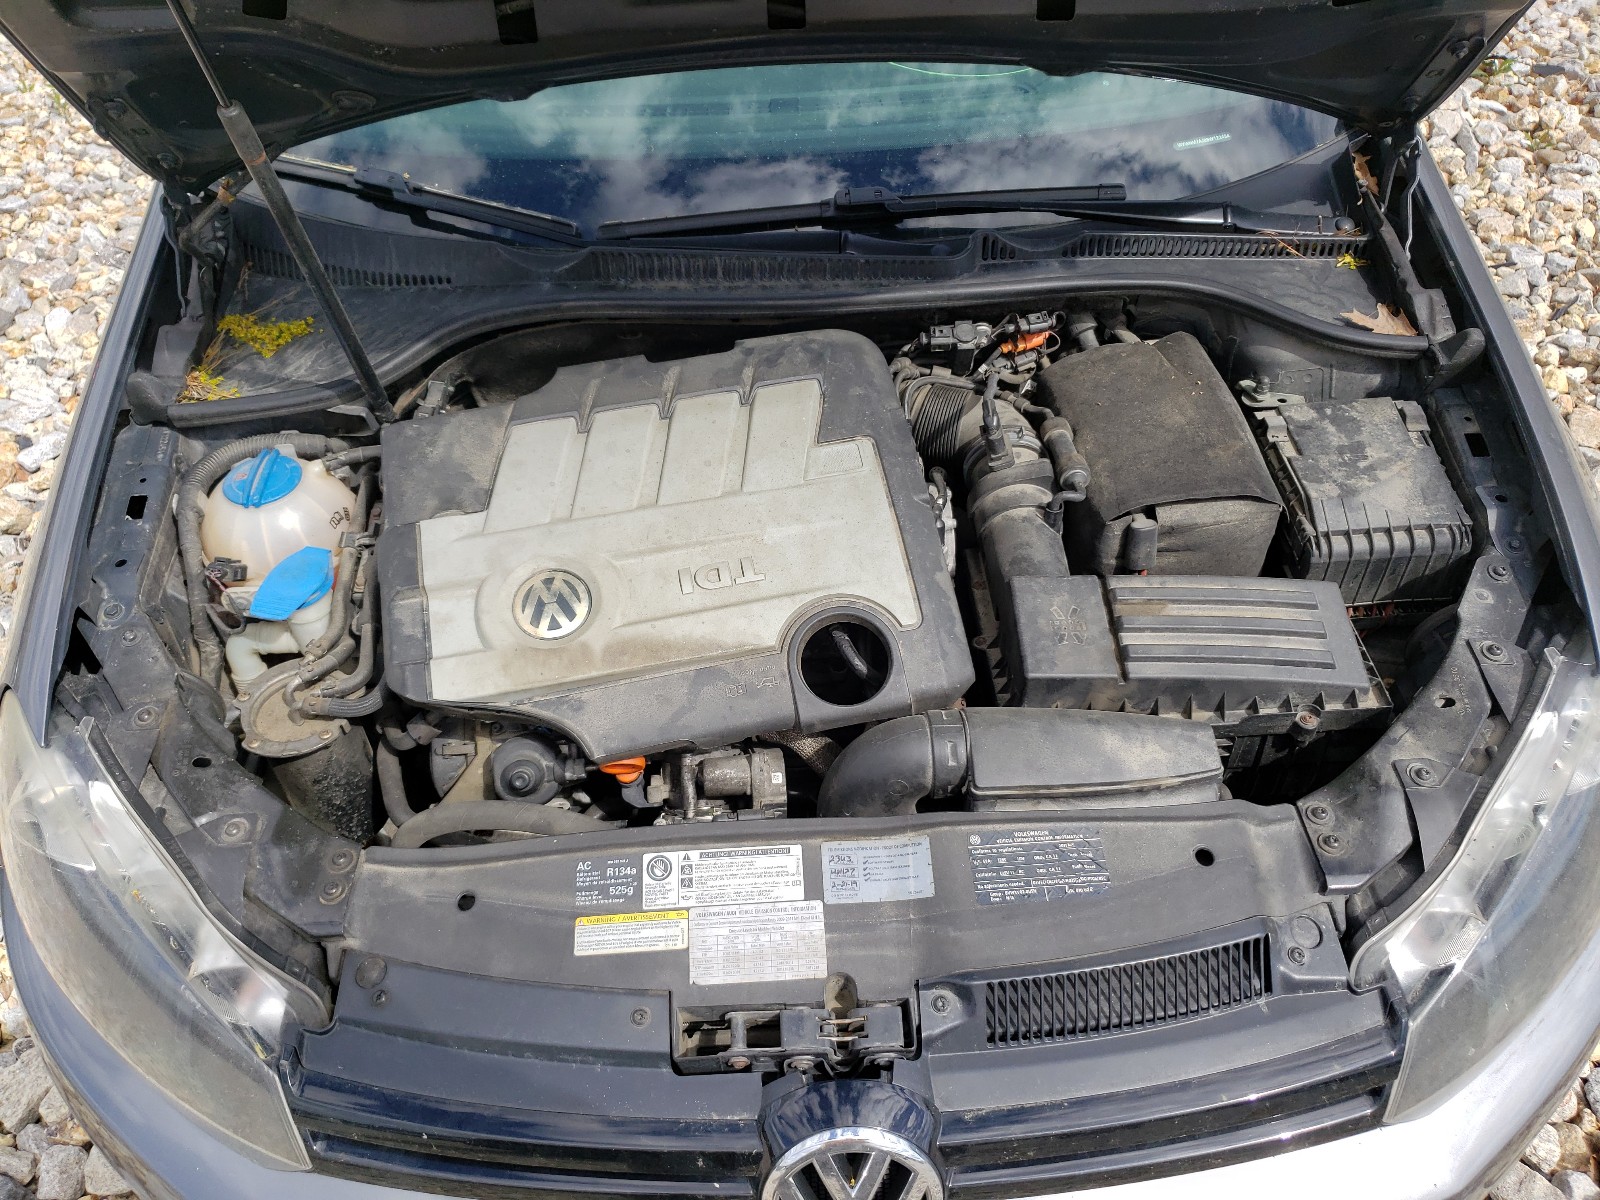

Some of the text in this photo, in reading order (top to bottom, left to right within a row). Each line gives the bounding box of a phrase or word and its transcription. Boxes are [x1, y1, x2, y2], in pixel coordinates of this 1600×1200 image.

[678, 556, 766, 595] TDI
[576, 861, 592, 871] AC
[606, 866, 637, 877] R134a
[609, 885, 634, 896] 525g
[586, 916, 617, 924] WARNING
[622, 912, 670, 922] AVERTISSEMENT
